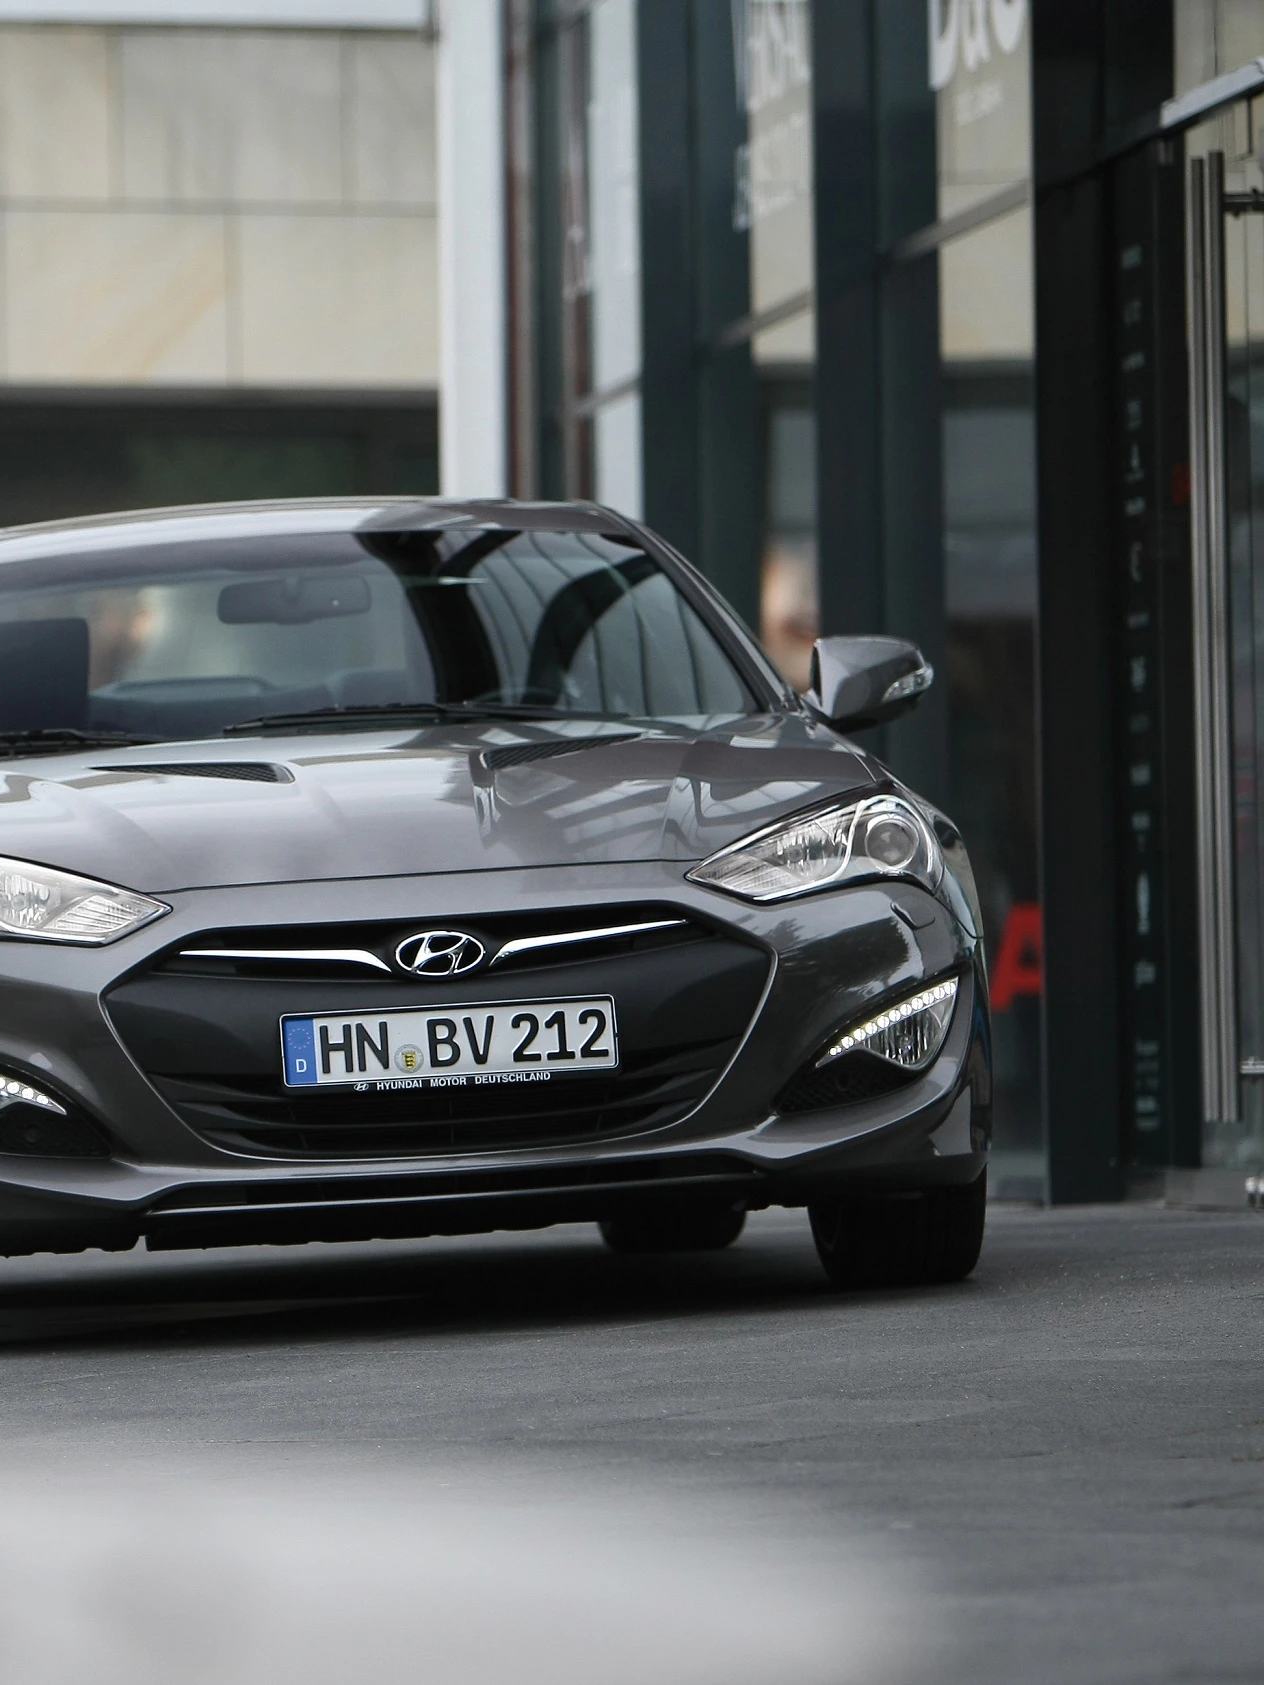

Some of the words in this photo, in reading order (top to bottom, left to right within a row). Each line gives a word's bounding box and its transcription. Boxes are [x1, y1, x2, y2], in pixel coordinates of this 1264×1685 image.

[319, 1021, 390, 1074] HN
[426, 1015, 494, 1068] BV
[511, 1008, 609, 1063] 212
[295, 1058, 307, 1073] D
[376, 1079, 422, 1091] HYUNDAI
[430, 1076, 467, 1087] MOTOR
[474, 1071, 551, 1085] DEUTSCHLAND
